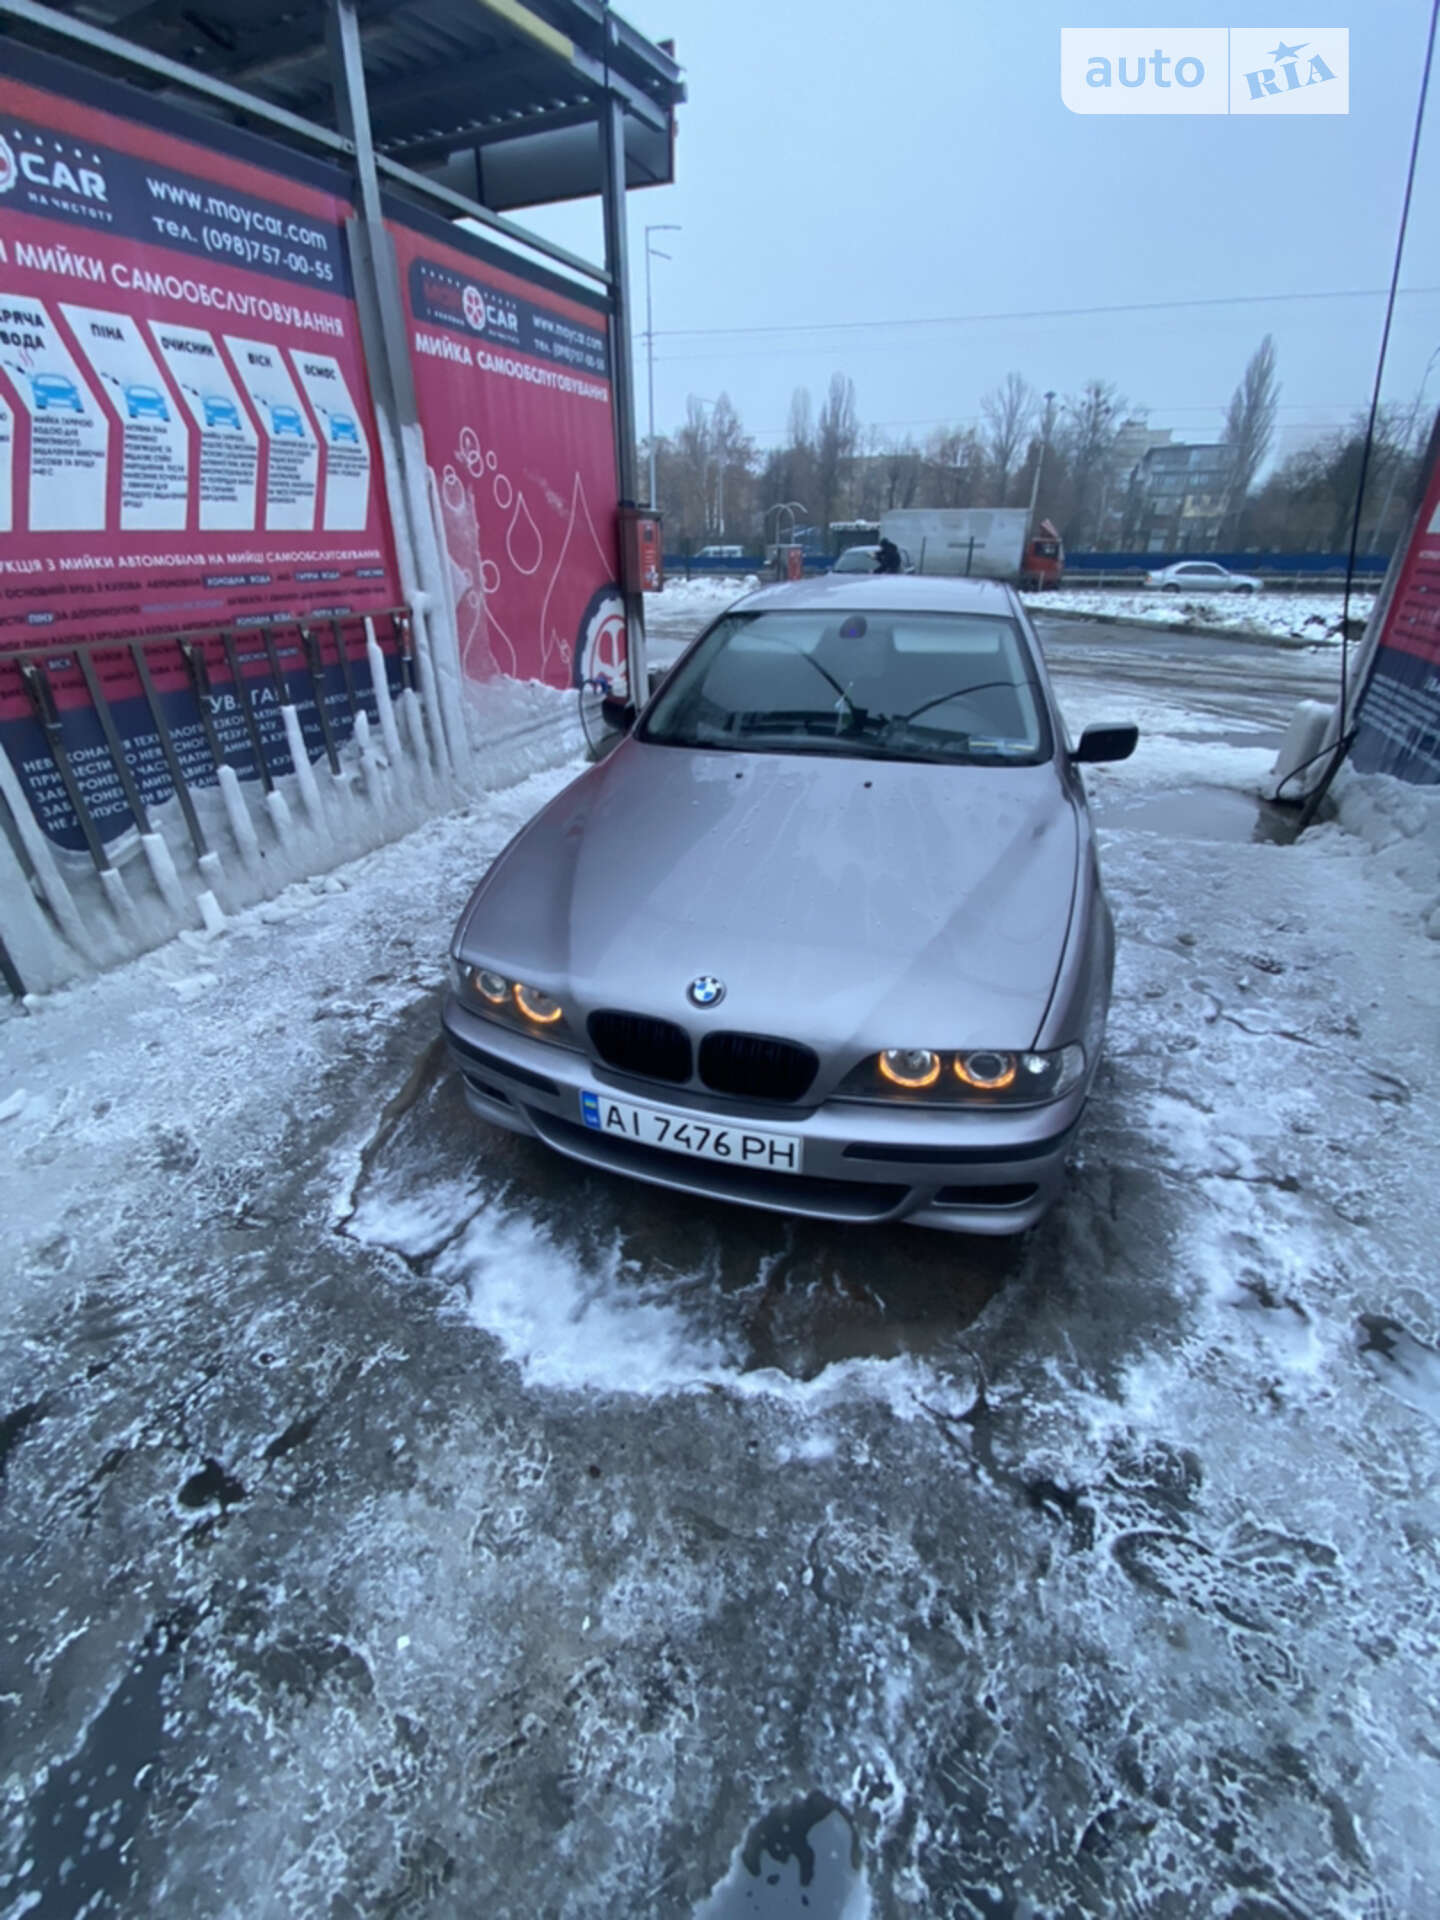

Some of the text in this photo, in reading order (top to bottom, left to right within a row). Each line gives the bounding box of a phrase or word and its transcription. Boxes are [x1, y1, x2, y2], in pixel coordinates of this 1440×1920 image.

[19, 151, 108, 203] CAR
[146, 177, 328, 251] www.moycar.com
[152, 216, 334, 282] тел. (098)757-00-55
[15, 240, 107, 284] МИЙКИ
[110, 263, 344, 337] САМООБСЛУГОВУВАННЯ
[0, 309, 45, 328] РЯЧА
[90, 322, 125, 341] ПІНА
[486, 305, 518, 333] CAR
[415, 332, 608, 402] МИЙКА САМООБСЛУГОВУВАННЯ
[59, 553, 114, 571] МИЙКИ
[606, 1105, 795, 1169] AI 7476 PH
